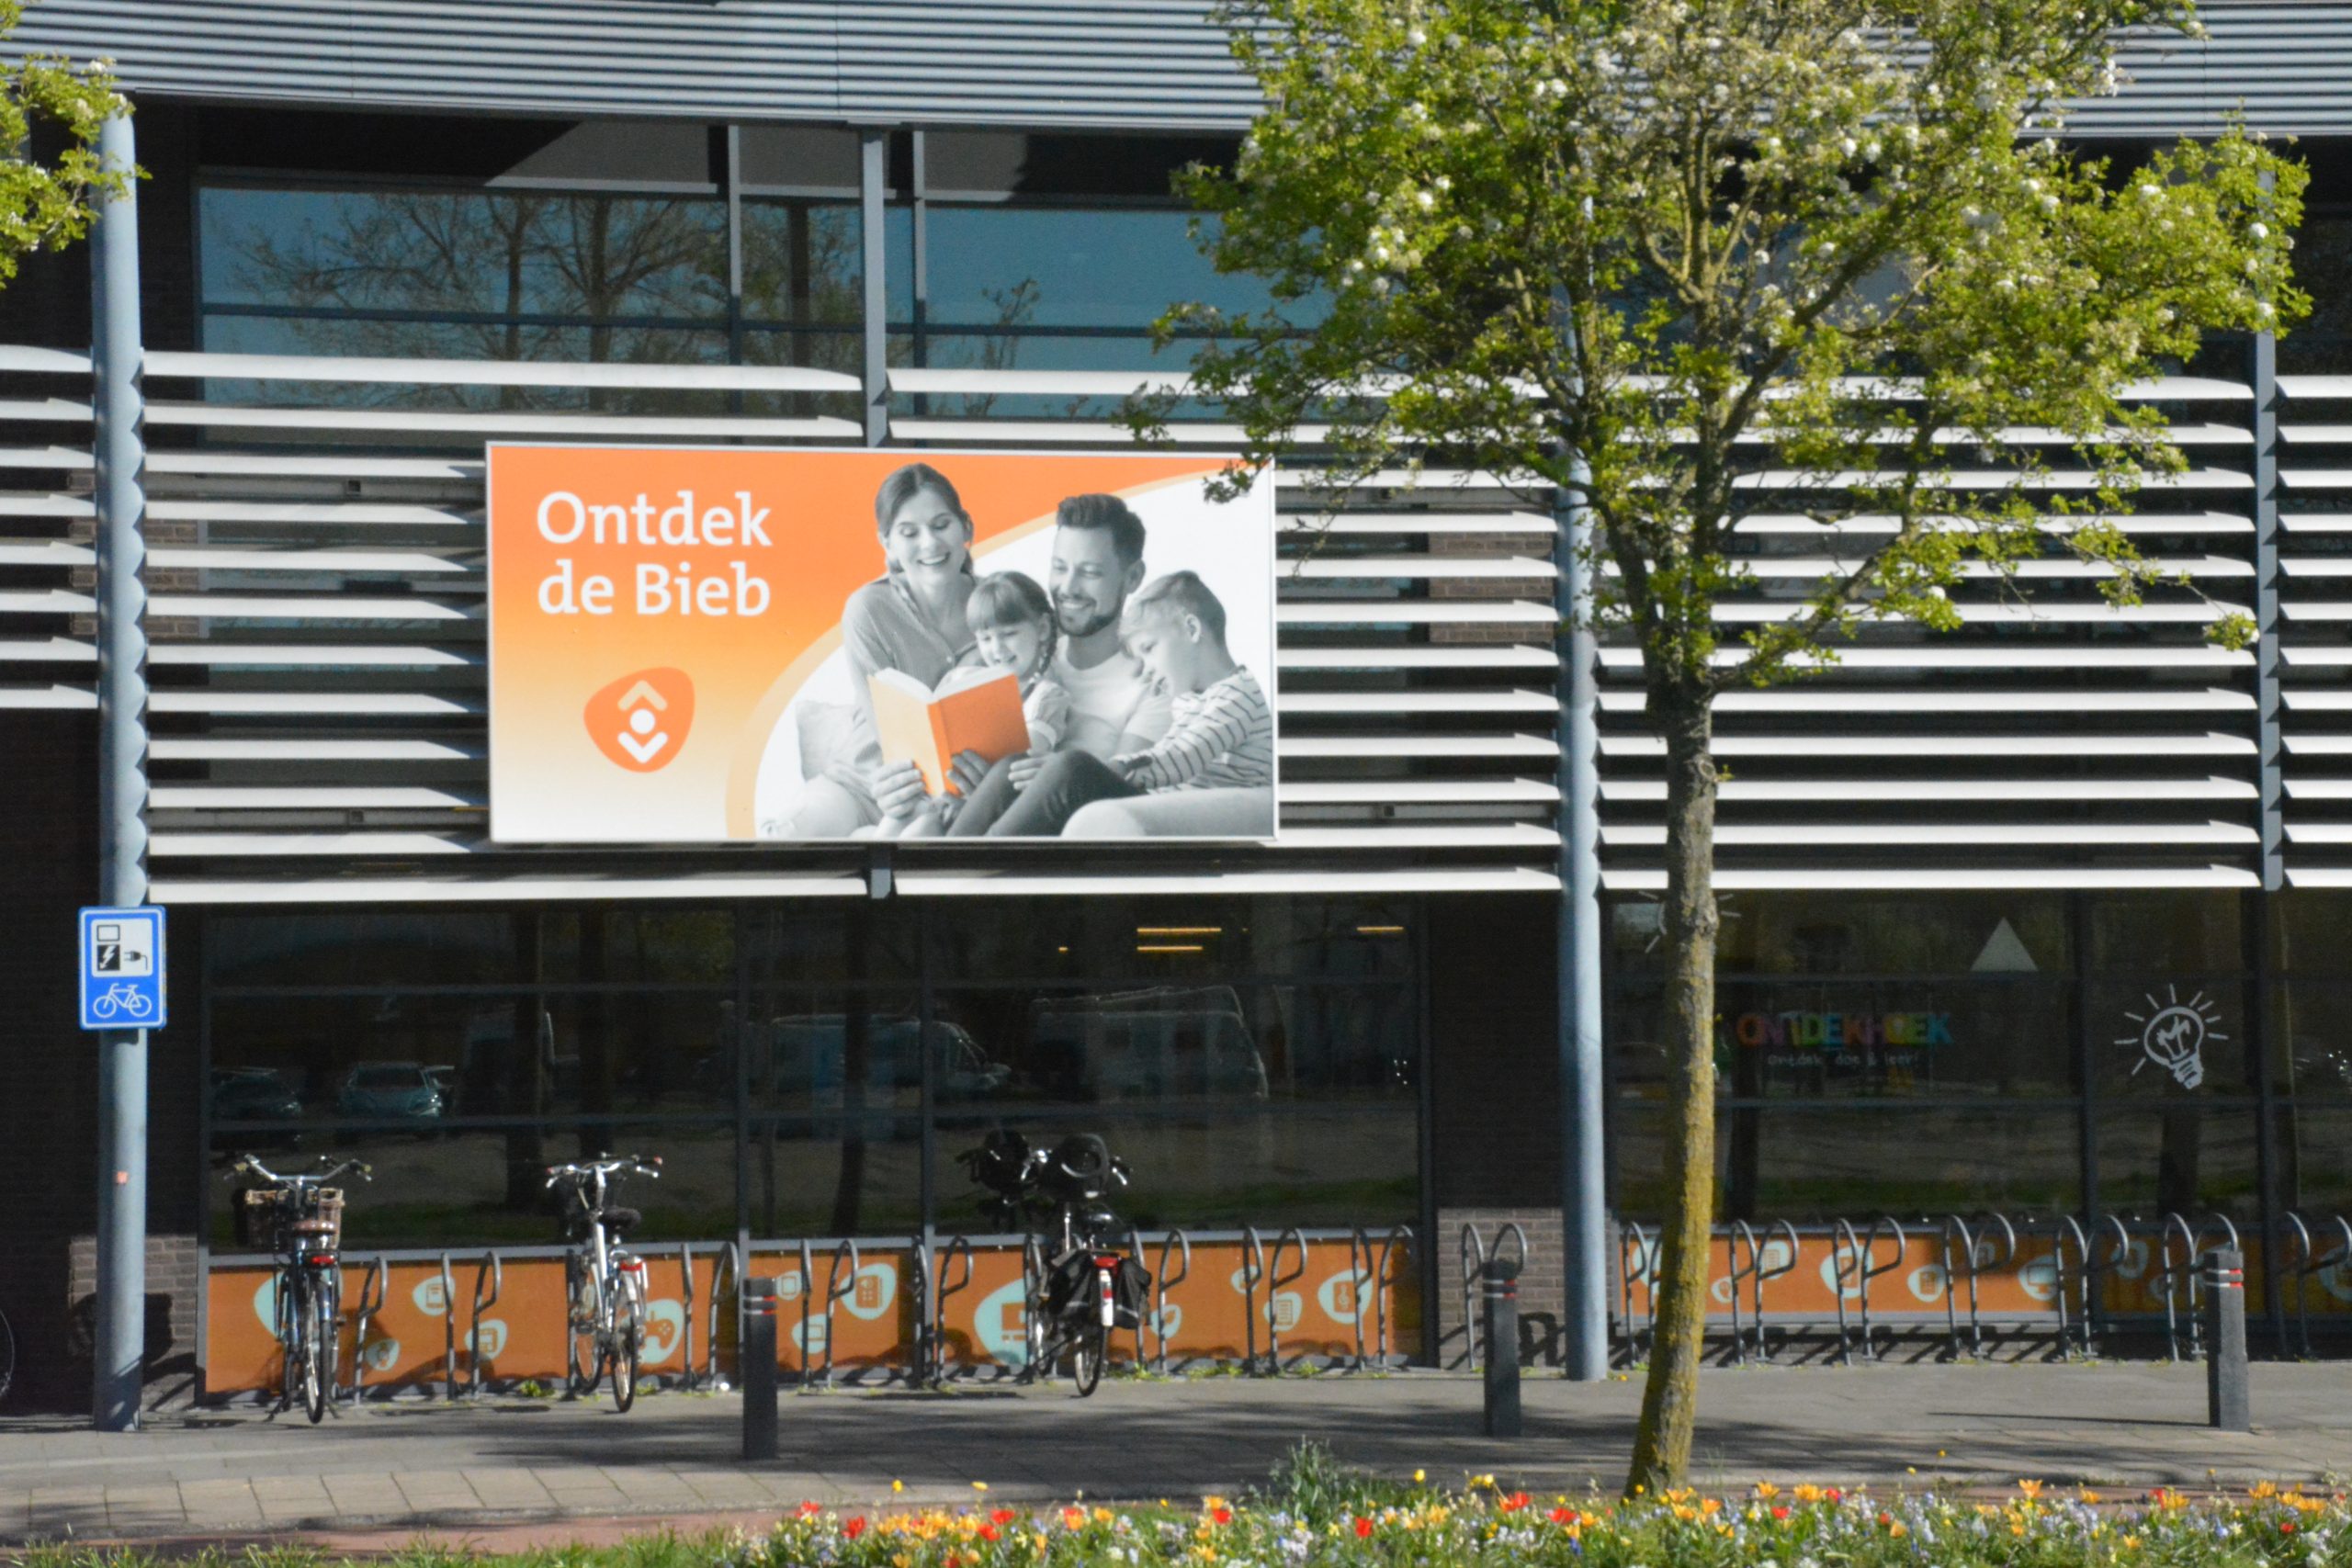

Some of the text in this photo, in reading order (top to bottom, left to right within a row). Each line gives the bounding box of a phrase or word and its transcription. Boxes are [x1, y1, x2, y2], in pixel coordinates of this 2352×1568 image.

[537, 490, 773, 547] Ontdek
[537, 558, 771, 616] de Bieb
